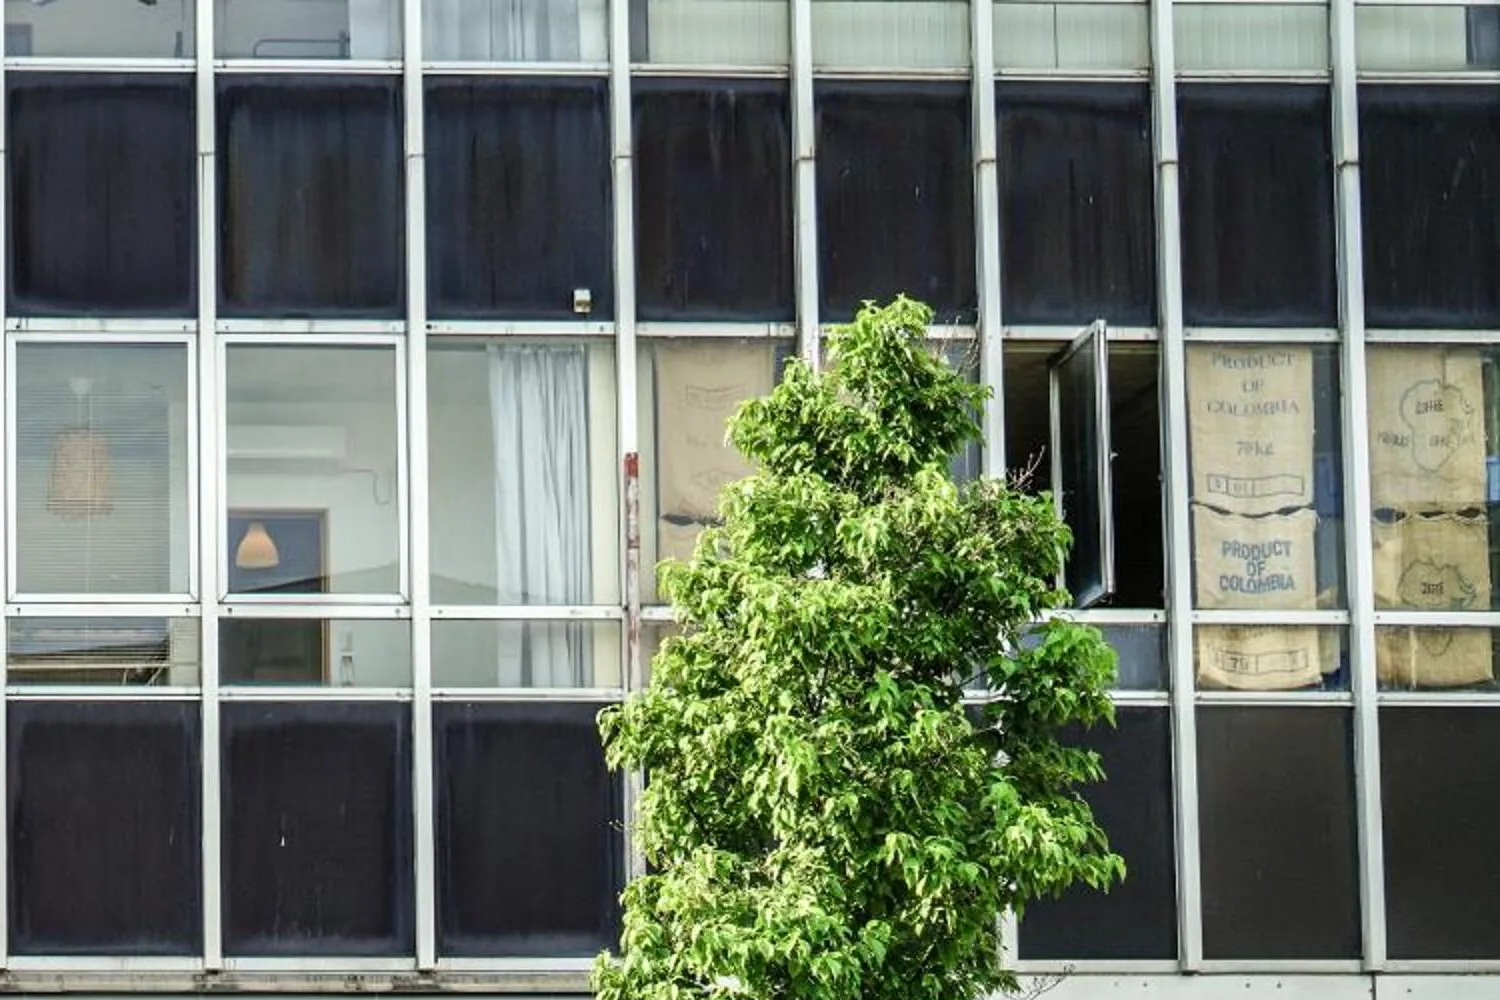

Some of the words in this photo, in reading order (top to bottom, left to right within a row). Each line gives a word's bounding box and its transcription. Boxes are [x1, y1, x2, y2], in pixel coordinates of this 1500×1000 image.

[1211, 351, 1296, 369] PRODUCT
[1242, 378, 1265, 393] OF
[1206, 399, 1300, 416] COLOMBIA
[1221, 540, 1293, 560] PRODUCT
[1246, 561, 1266, 577] OF
[1219, 574, 1297, 594] COLOMBIA
